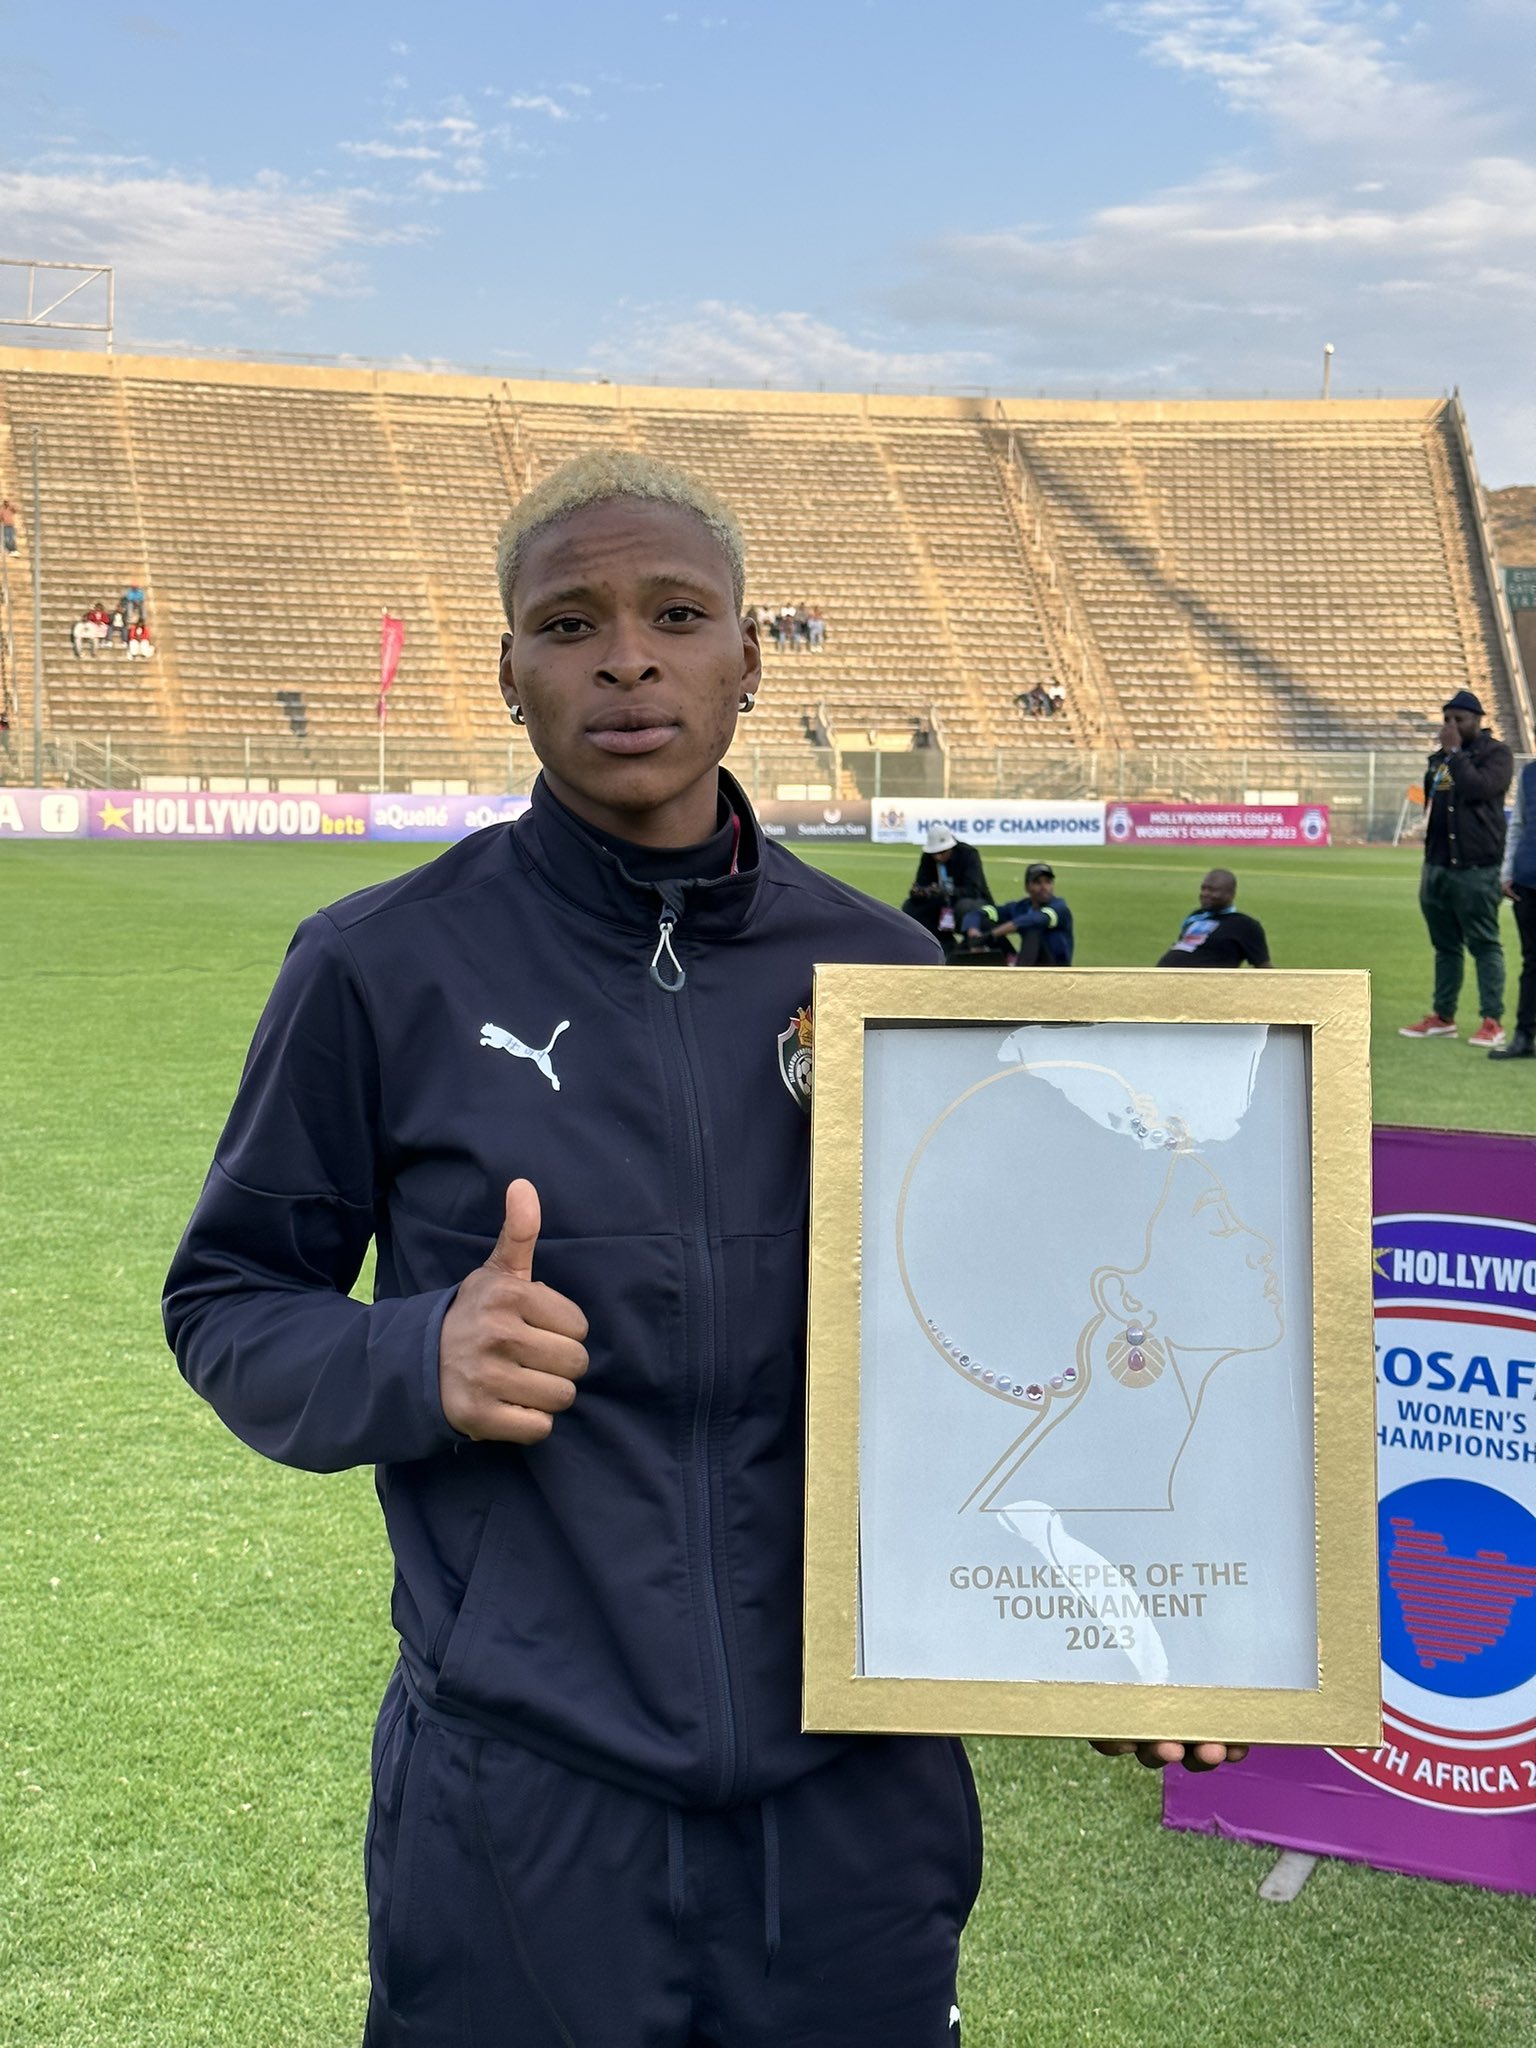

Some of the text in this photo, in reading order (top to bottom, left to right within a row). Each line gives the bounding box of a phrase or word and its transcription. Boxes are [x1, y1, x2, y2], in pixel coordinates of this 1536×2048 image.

[374, 804, 448, 830] aQuellé
[846, 822, 867, 836] Sun
[918, 818, 1100, 833] HME OF CHAMPIONS
[1150, 812, 1284, 826] HOLLYWOODBETS COSAFA
[1135, 825, 1297, 839] WOMEN'S CHAMPIONSHIP 2023
[1374, 1345, 1536, 1400] OSAF
[1397, 1399, 1527, 1434] WOMEN'S
[950, 1561, 1249, 1590] GOALKEEPER OF THE
[993, 1593, 1208, 1620] TOURNAMENT
[1065, 1624, 1136, 1651] 2023
[1413, 1757, 1520, 1794] AFRICA
